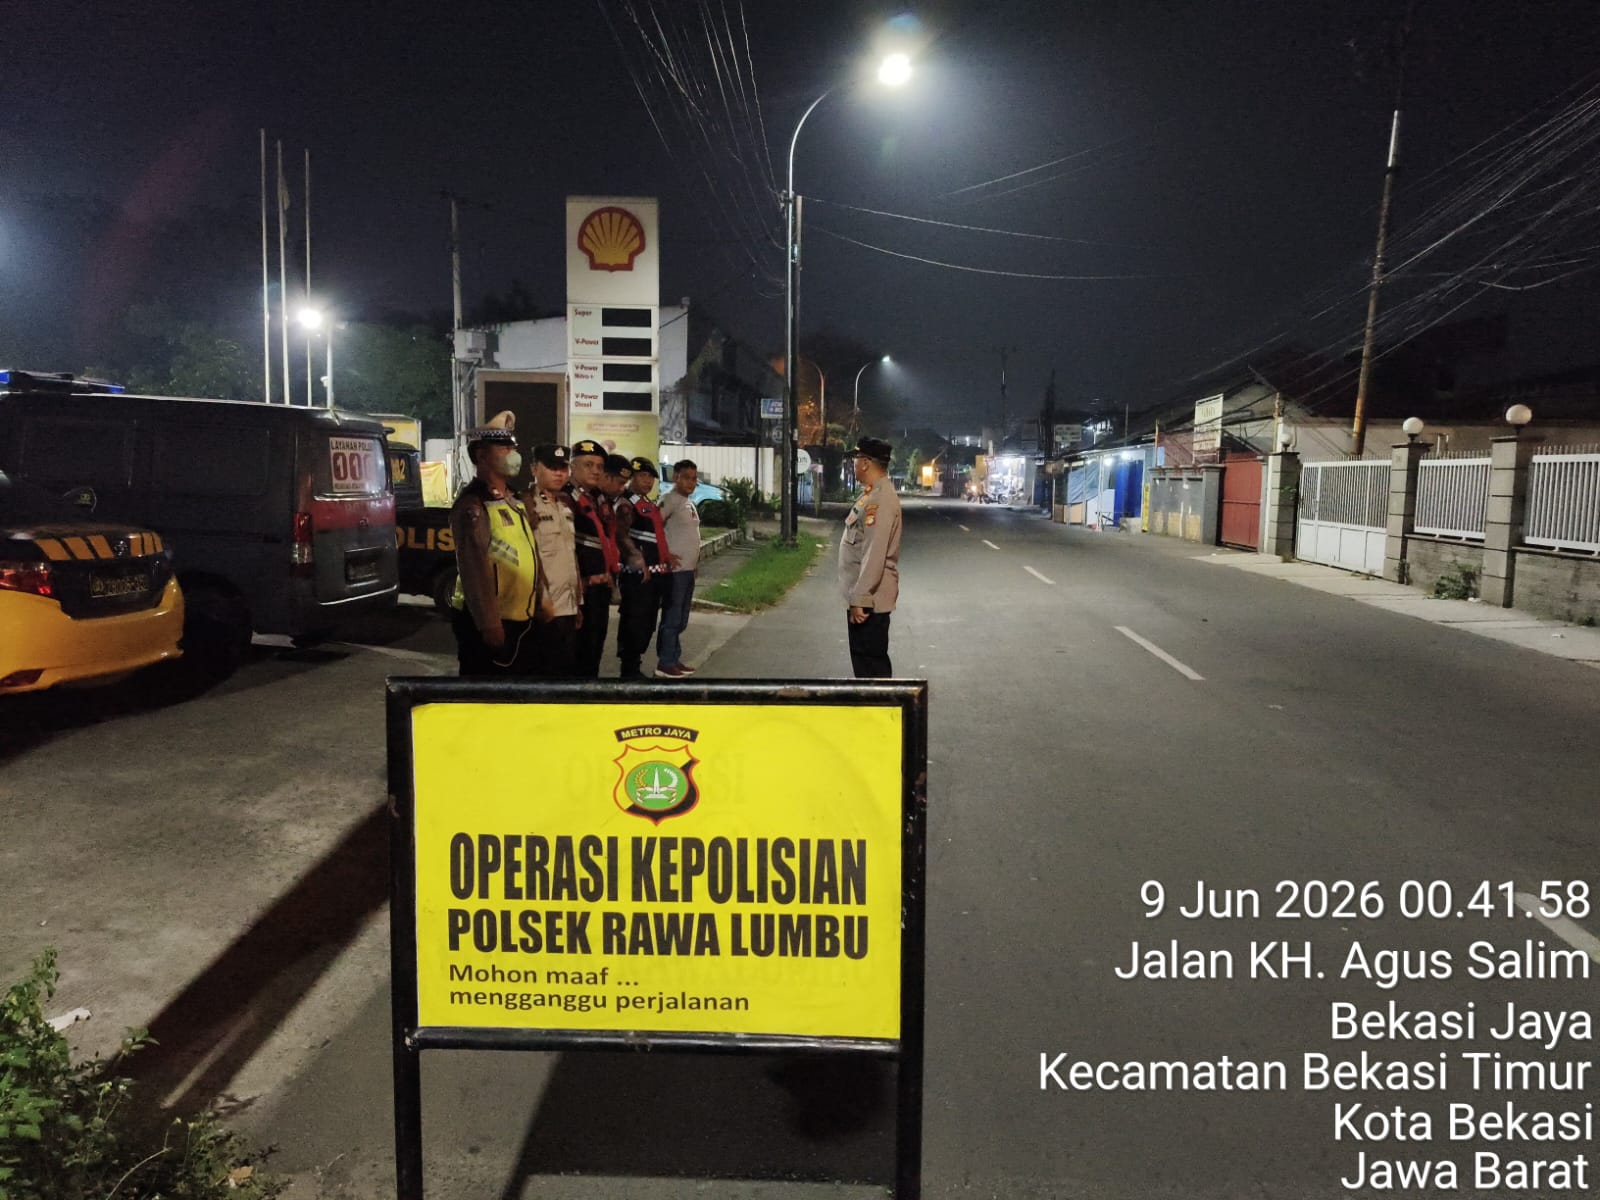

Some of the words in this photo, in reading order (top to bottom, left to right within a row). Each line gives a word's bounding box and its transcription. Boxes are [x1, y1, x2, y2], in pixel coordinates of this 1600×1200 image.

[574, 308, 592, 317] Super
[575, 392, 599, 400] V-Power
[621, 728, 661, 739] METRO
[664, 728, 691, 739] JAYA
[449, 833, 618, 903] OPERASI
[631, 837, 866, 905] KEPOLISIAN
[448, 908, 591, 955] POLSEK
[602, 912, 721, 956] RAWA
[731, 914, 869, 960] LUMBU
[449, 964, 537, 983] Mohon
[546, 967, 609, 985] maaf
[450, 990, 607, 1013] mengganggu
[616, 991, 749, 1013] perjalanan
